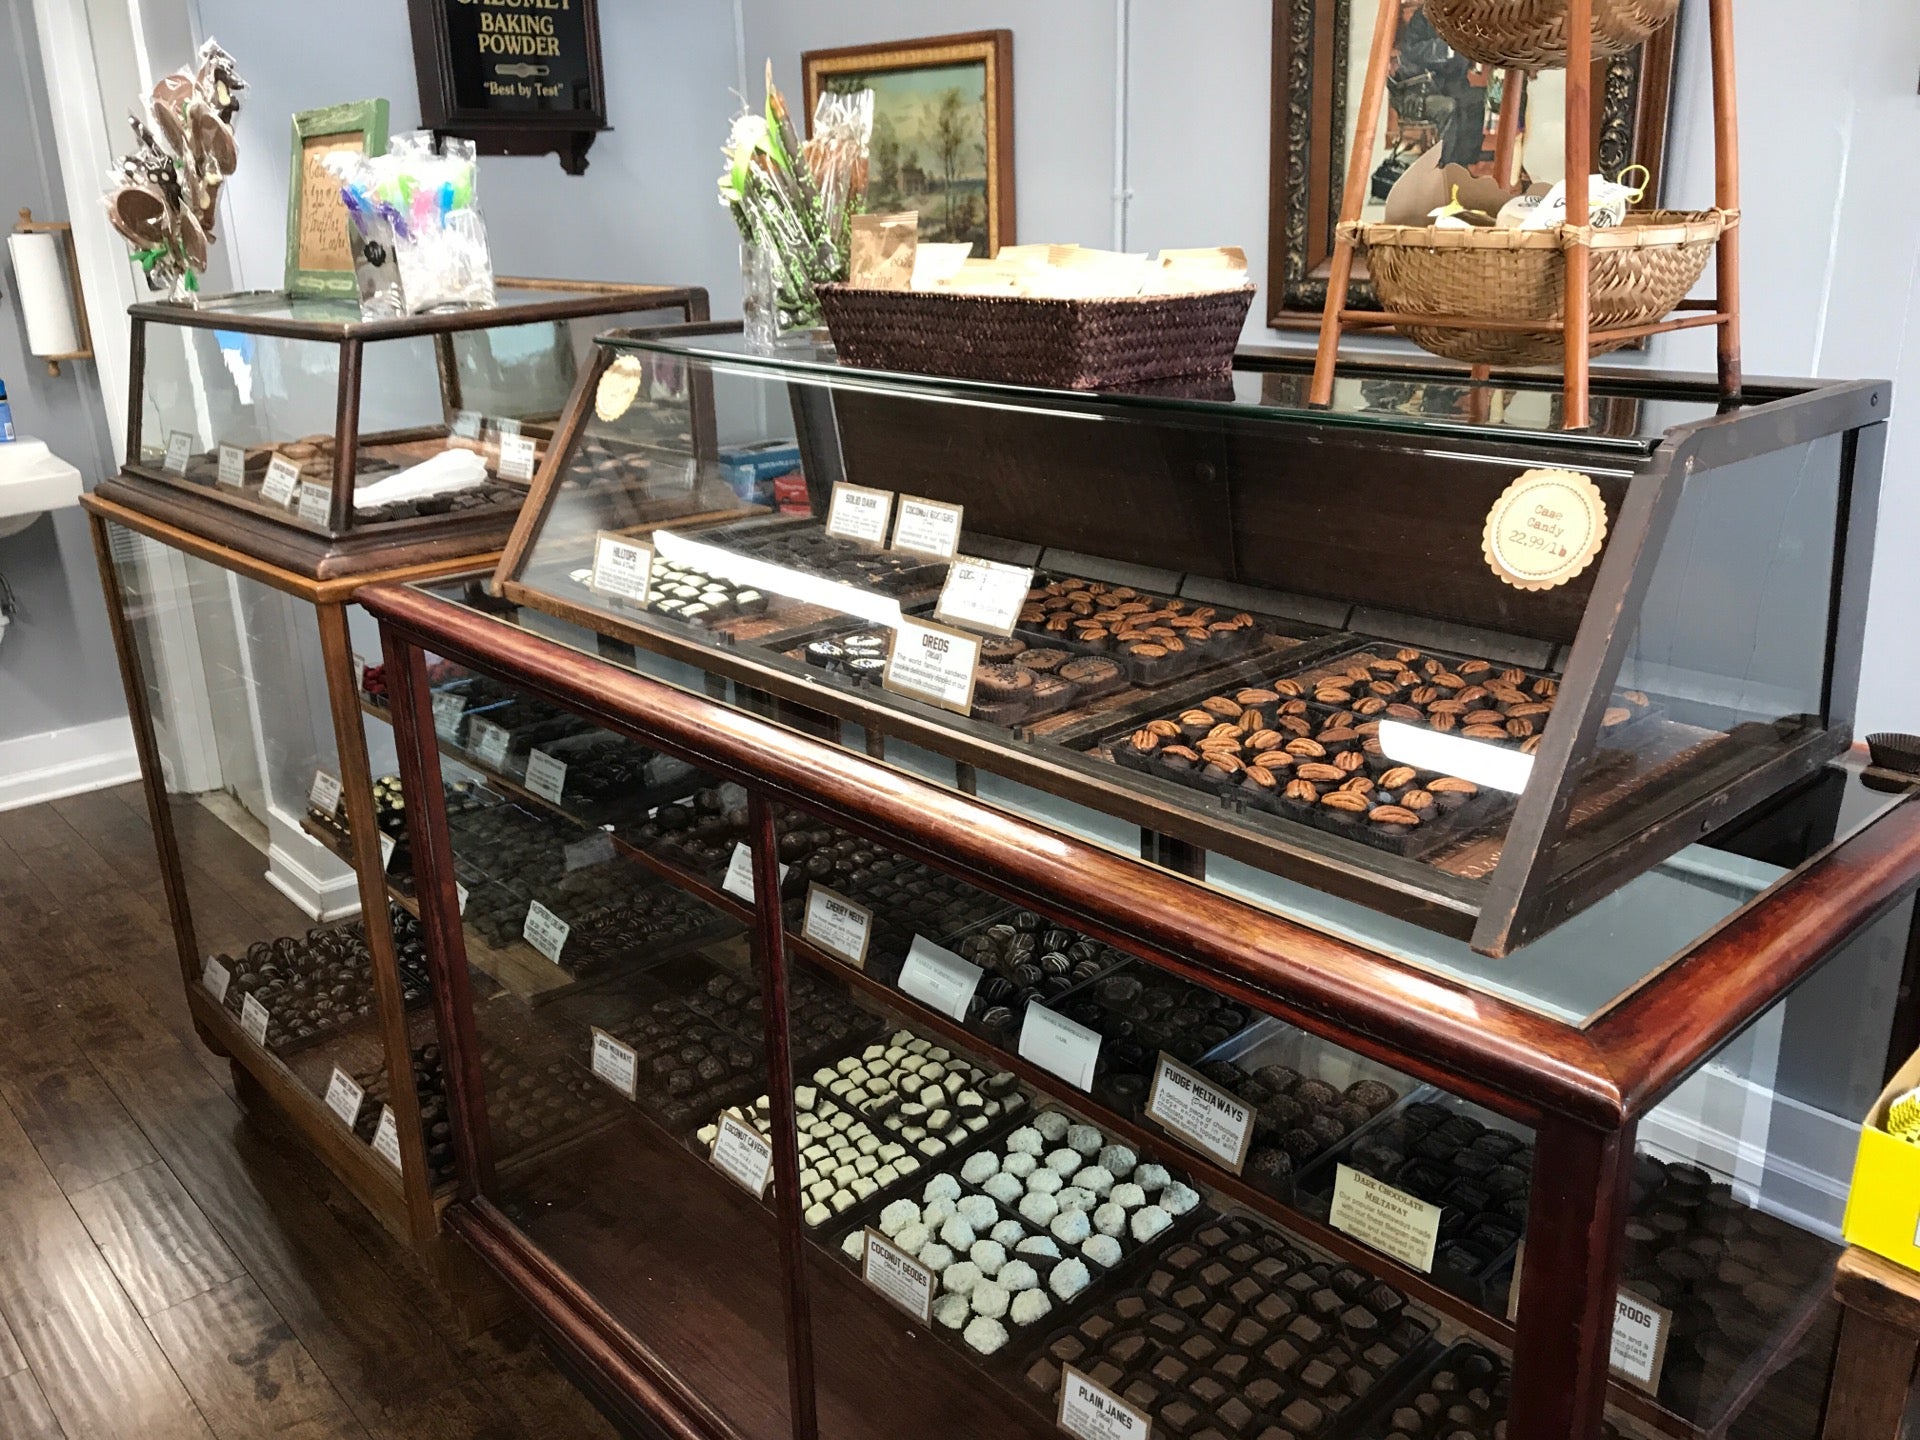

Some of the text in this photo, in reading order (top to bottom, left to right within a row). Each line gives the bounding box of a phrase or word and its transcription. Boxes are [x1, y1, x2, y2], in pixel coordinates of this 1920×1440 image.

[480, 12, 554, 35] BAKING
[478, 33, 561, 56] POWDER
[483, 81, 564, 98] "Best by Test"
[845, 494, 877, 508] SOLID DARK
[1535, 504, 1563, 521] Case
[1527, 517, 1564, 538] Candy
[613, 546, 637, 562] HILLTOPS
[922, 634, 950, 653] OREOS
[826, 899, 864, 925] CHERRY MELTS
[1164, 1066, 1243, 1123] FUDGE MELTAWAYS
[725, 1120, 769, 1159] COCONUT CAVERNS
[1181, 1108, 1208, 1129] enrobed
[1222, 1134, 1236, 1147] dark
[1186, 1119, 1196, 1128] and
[1199, 1127, 1220, 1144] topped
[1354, 1173, 1424, 1212] DARK CHOCOLATE
[1365, 1191, 1408, 1218] MELTAWAY
[871, 1240, 901, 1269] COCONUT
[902, 1261, 927, 1287] GEODES
[1628, 1335, 1642, 1347] and
[1079, 1385, 1104, 1410] PLAIN
[1105, 1403, 1133, 1430] JANES
